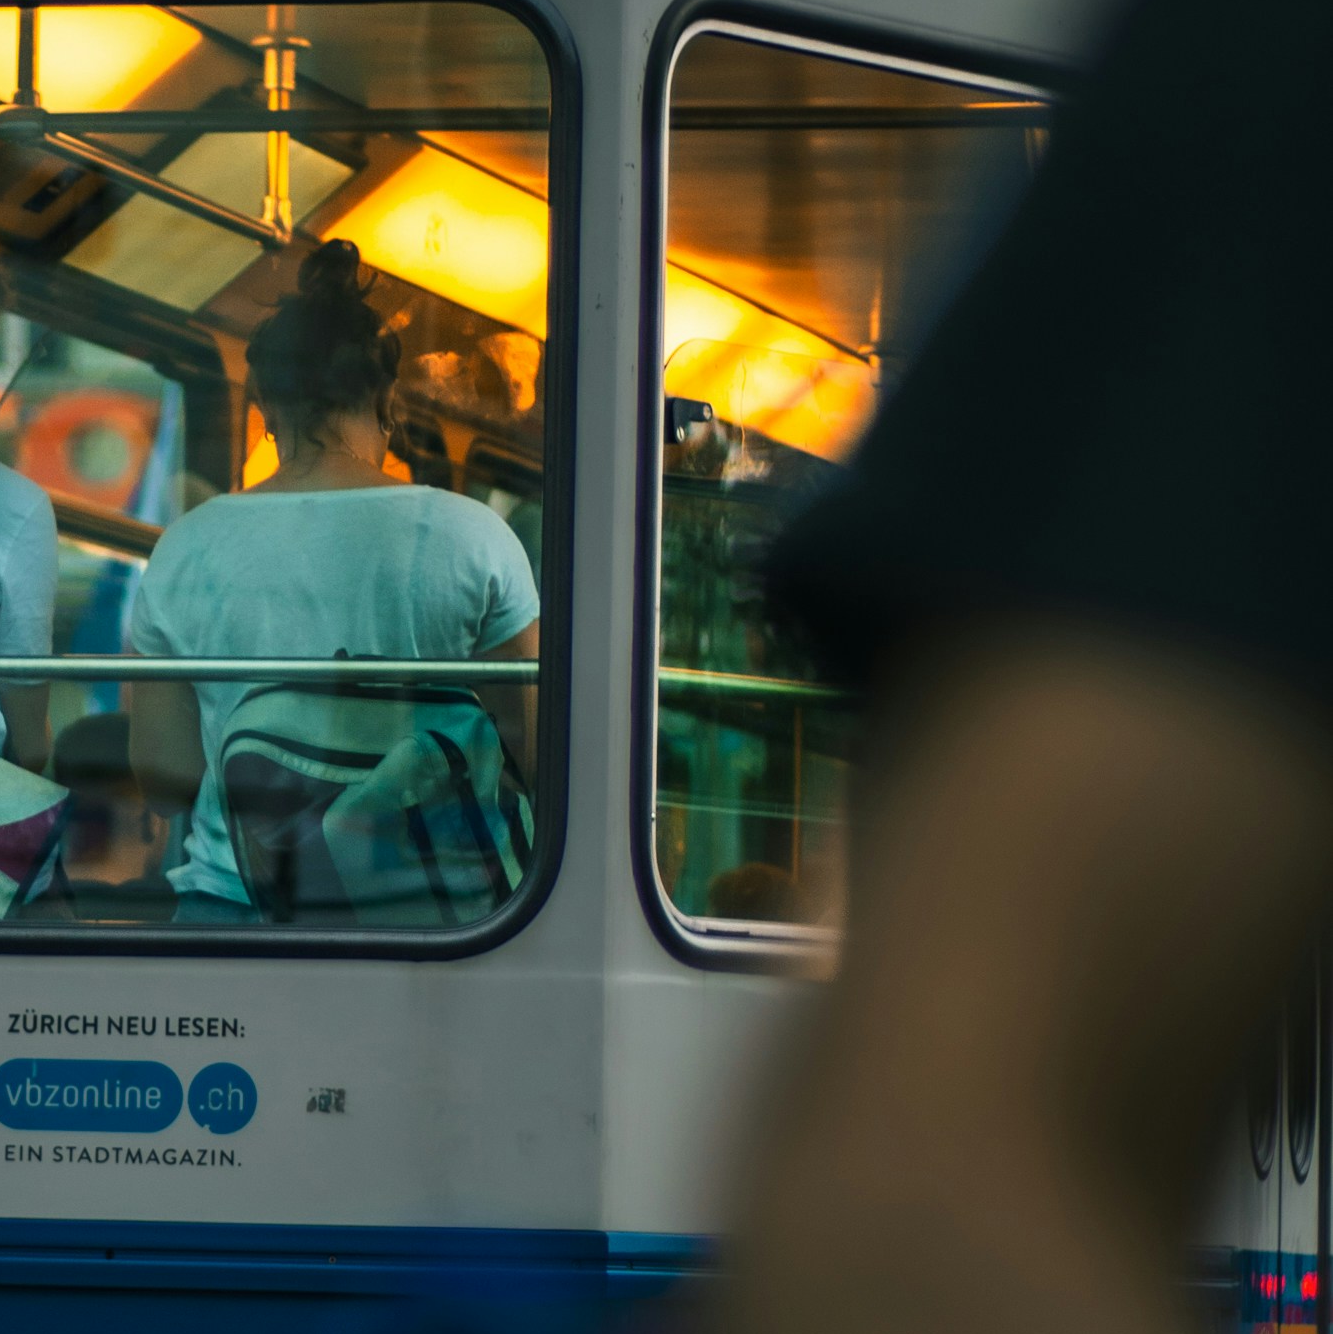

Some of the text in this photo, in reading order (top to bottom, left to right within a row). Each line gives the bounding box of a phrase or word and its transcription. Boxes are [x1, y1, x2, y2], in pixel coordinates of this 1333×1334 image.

[7, 1009, 246, 1038] ZÜRICH NEU LESEN:
[5, 1077, 162, 1110] vbzonline
[4, 1144, 243, 1167] EIN STADTMAGAZIN.
